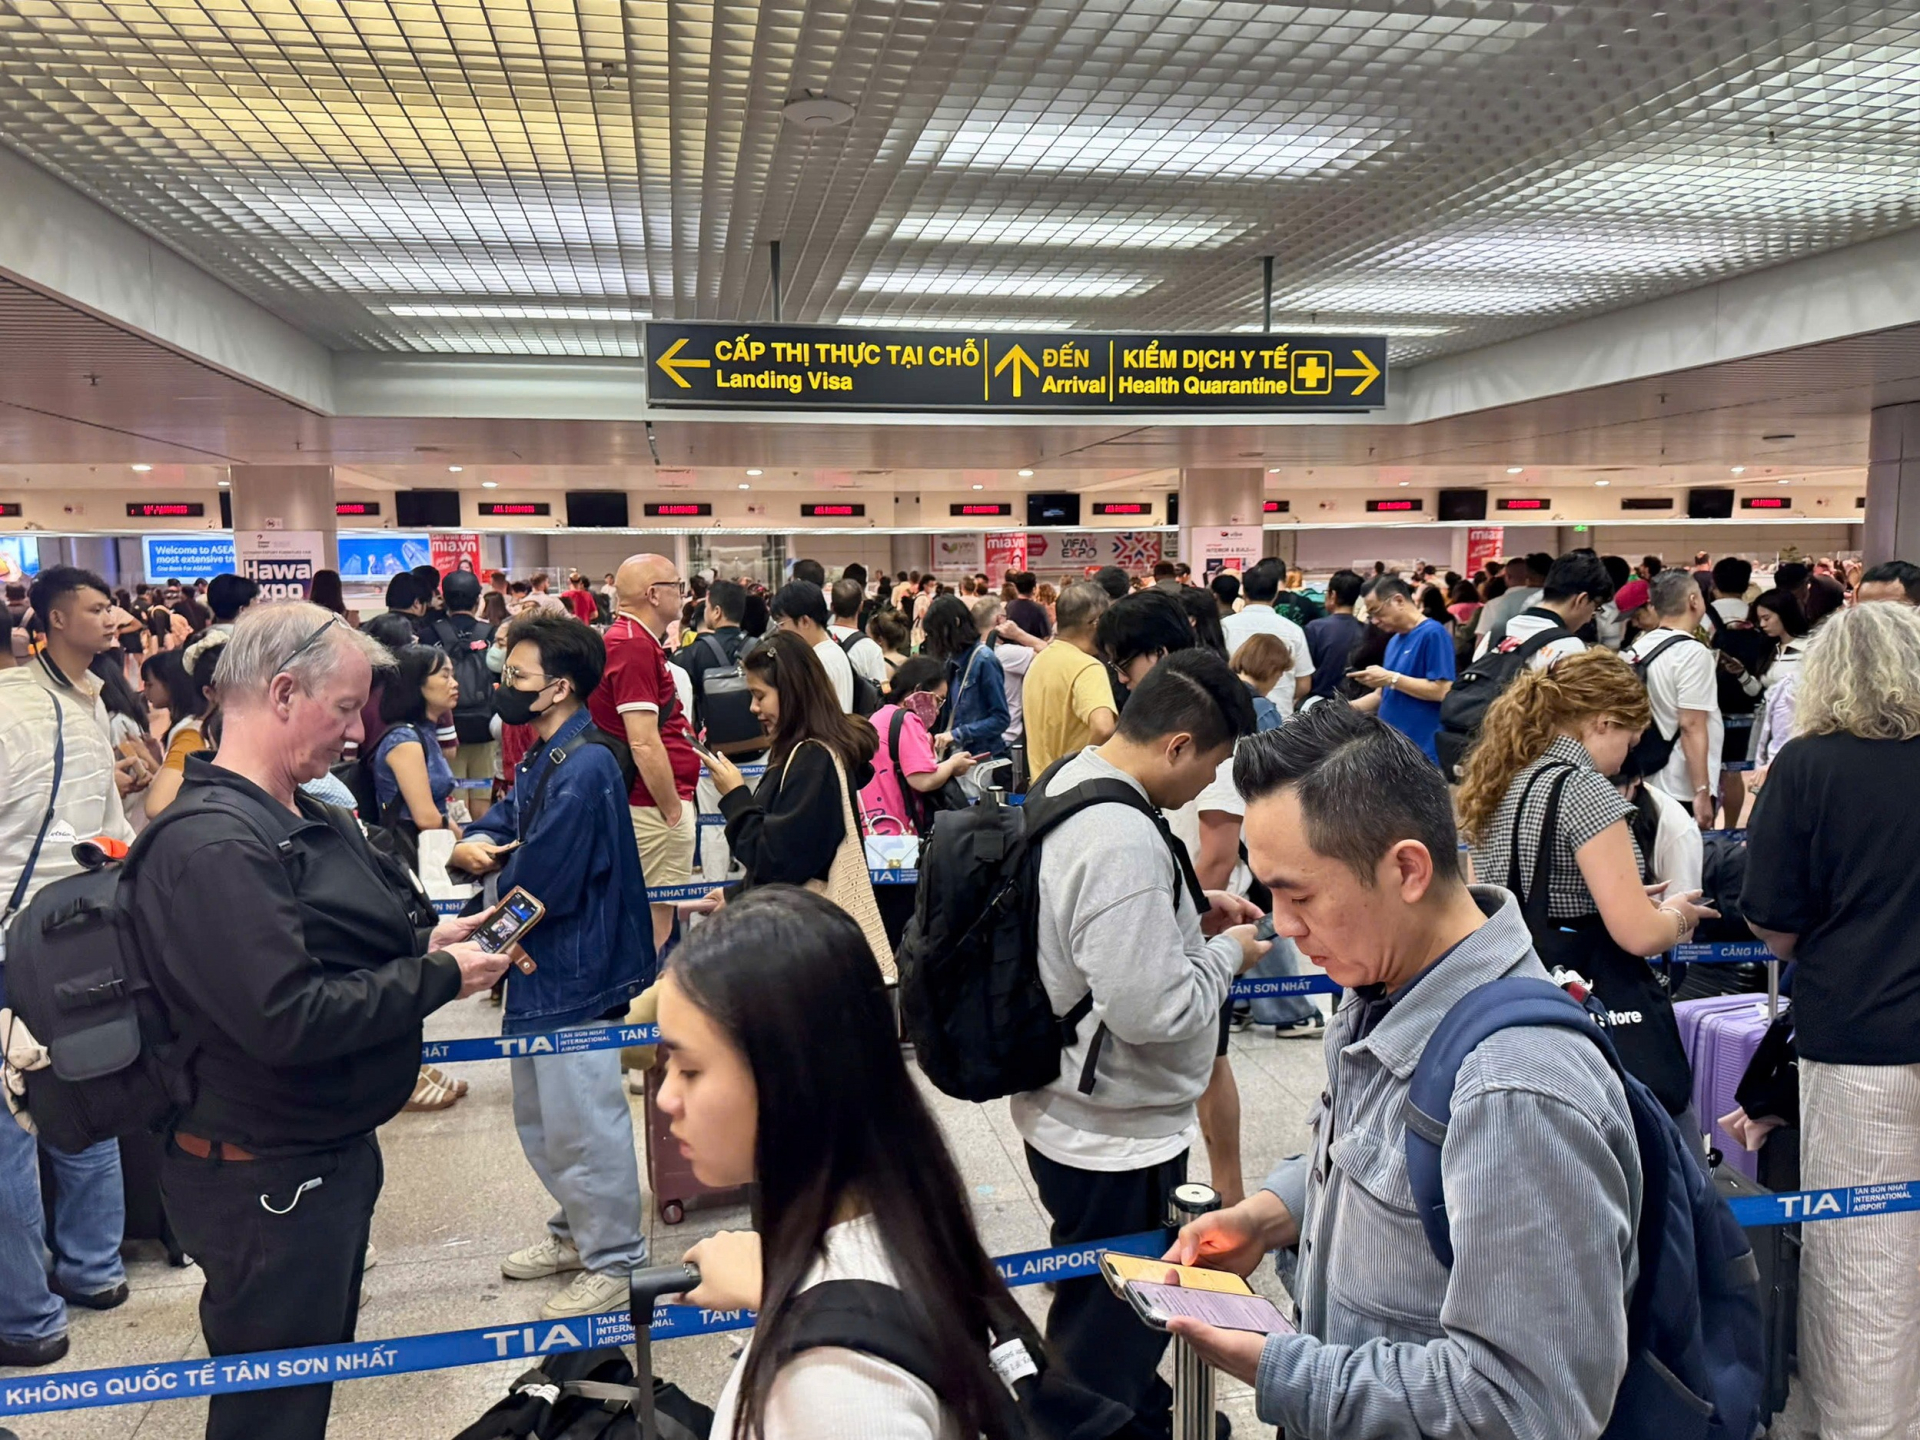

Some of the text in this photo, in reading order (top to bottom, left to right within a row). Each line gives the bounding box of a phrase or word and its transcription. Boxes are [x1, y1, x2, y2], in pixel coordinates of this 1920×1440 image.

[715, 334, 980, 368] CẤP THỊ THỰC TẠI CHỖ
[1043, 342, 1089, 368] ĐẾN
[1123, 340, 1289, 373] KIỂM DỊCH Y TẾ
[716, 369, 853, 393] Landing Visa
[1042, 376, 1106, 393] Arrival
[1119, 376, 1288, 395] Health Quarantine
[155, 546, 197, 554] Welcome
[199, 546, 209, 554] to
[432, 541, 477, 552] mia.vn
[987, 538, 1024, 549] mia.vn
[181, 555, 223, 563] extensive
[1061, 547, 1097, 558] EXPO
[244, 560, 311, 580] Hawa
[255, 582, 304, 602] xpo
[660, 889, 685, 897] NHAT
[560, 1036, 610, 1045] INTERNATIONAL
[619, 1026, 661, 1041] TAN S
[494, 1036, 554, 1055] TIA
[561, 1044, 589, 1052] AIRPORT
[1887, 1183, 1907, 1191] NHAT
[1853, 1191, 1912, 1203] INTERNATIONAL
[1777, 1193, 1841, 1217] TIA
[1853, 1202, 1887, 1212] AIRPORT
[596, 1315, 616, 1325] TAN
[699, 1309, 740, 1324] TAN
[483, 1324, 582, 1357] TIA
[597, 1333, 636, 1345] AIRPOR
[6, 1344, 398, 1406] KHÔNG QUỐC TẾ TÂN SƠN NHẤT
